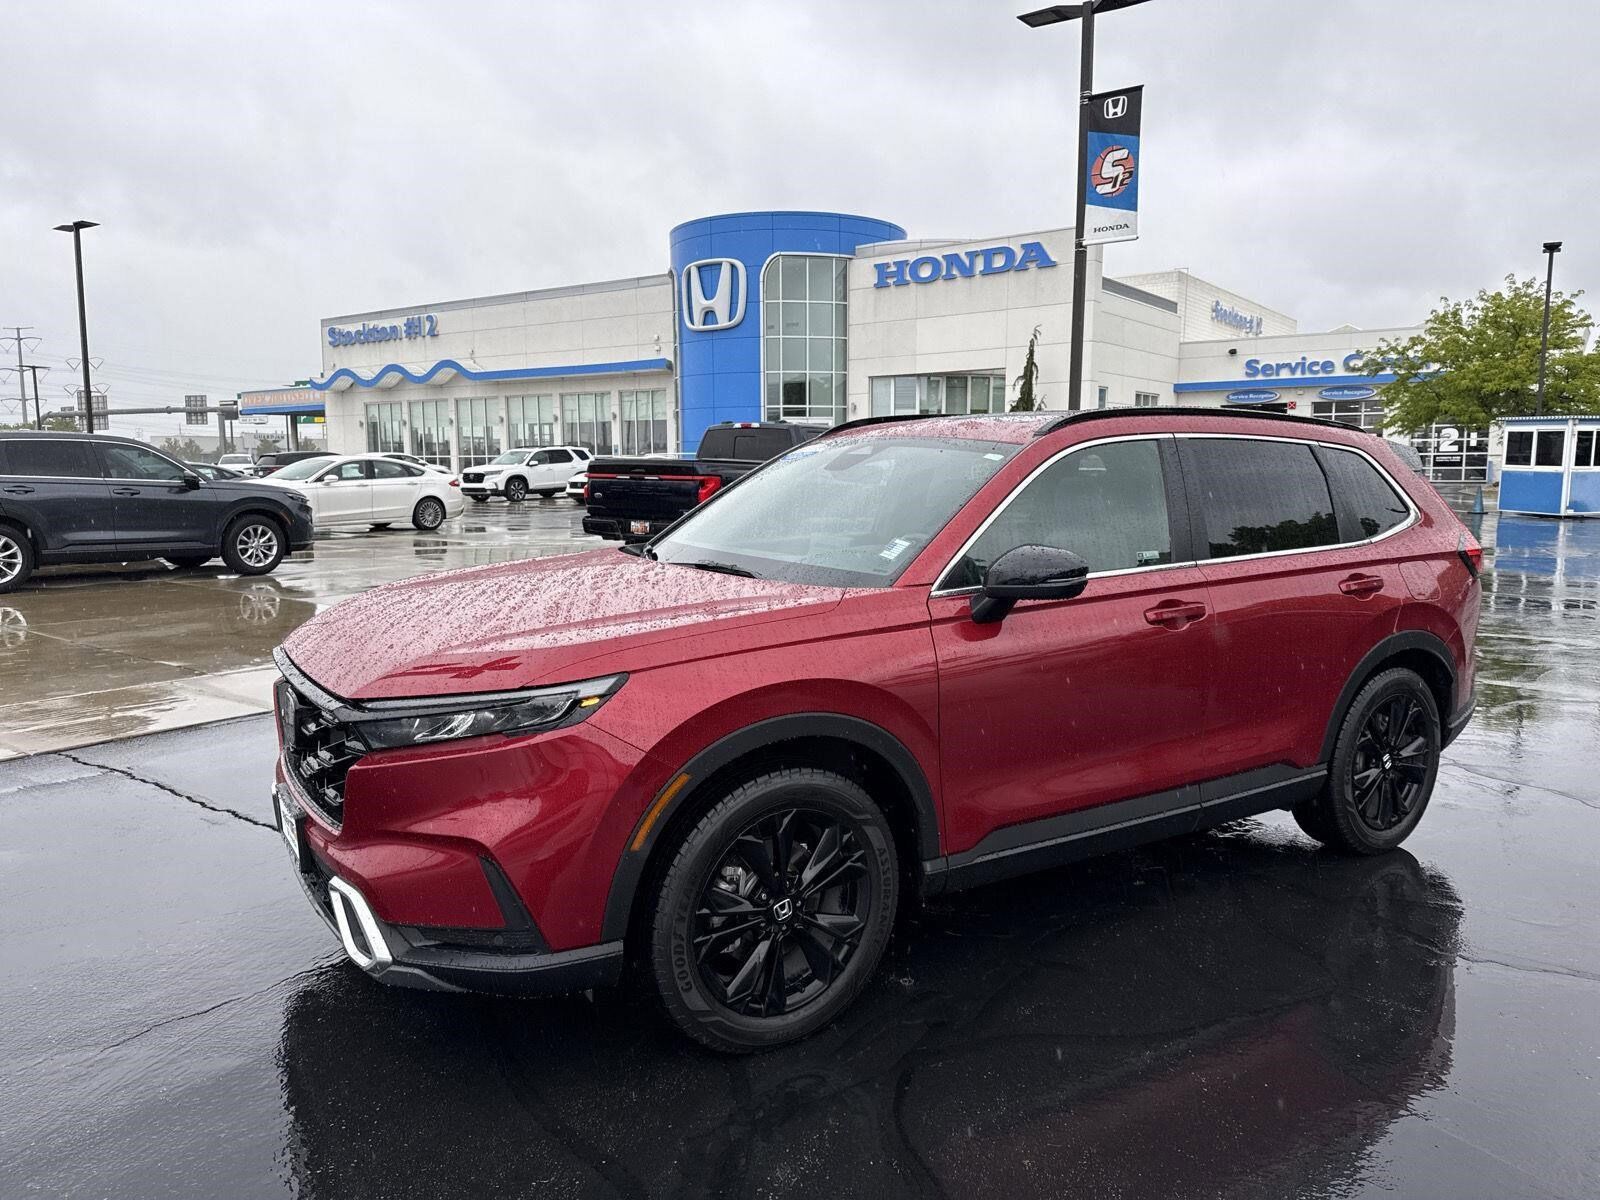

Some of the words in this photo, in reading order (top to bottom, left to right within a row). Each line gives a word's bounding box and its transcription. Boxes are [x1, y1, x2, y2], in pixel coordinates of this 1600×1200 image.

[1093, 223, 1130, 233] HONDA
[873, 241, 1057, 288] HONDA
[328, 323, 401, 346] Stockton
[1245, 356, 1335, 378] Service
[1249, 392, 1276, 400] Reception
[1321, 389, 1343, 397] Service
[1344, 388, 1374, 397] Reception
[1438, 427, 1460, 452] 2
